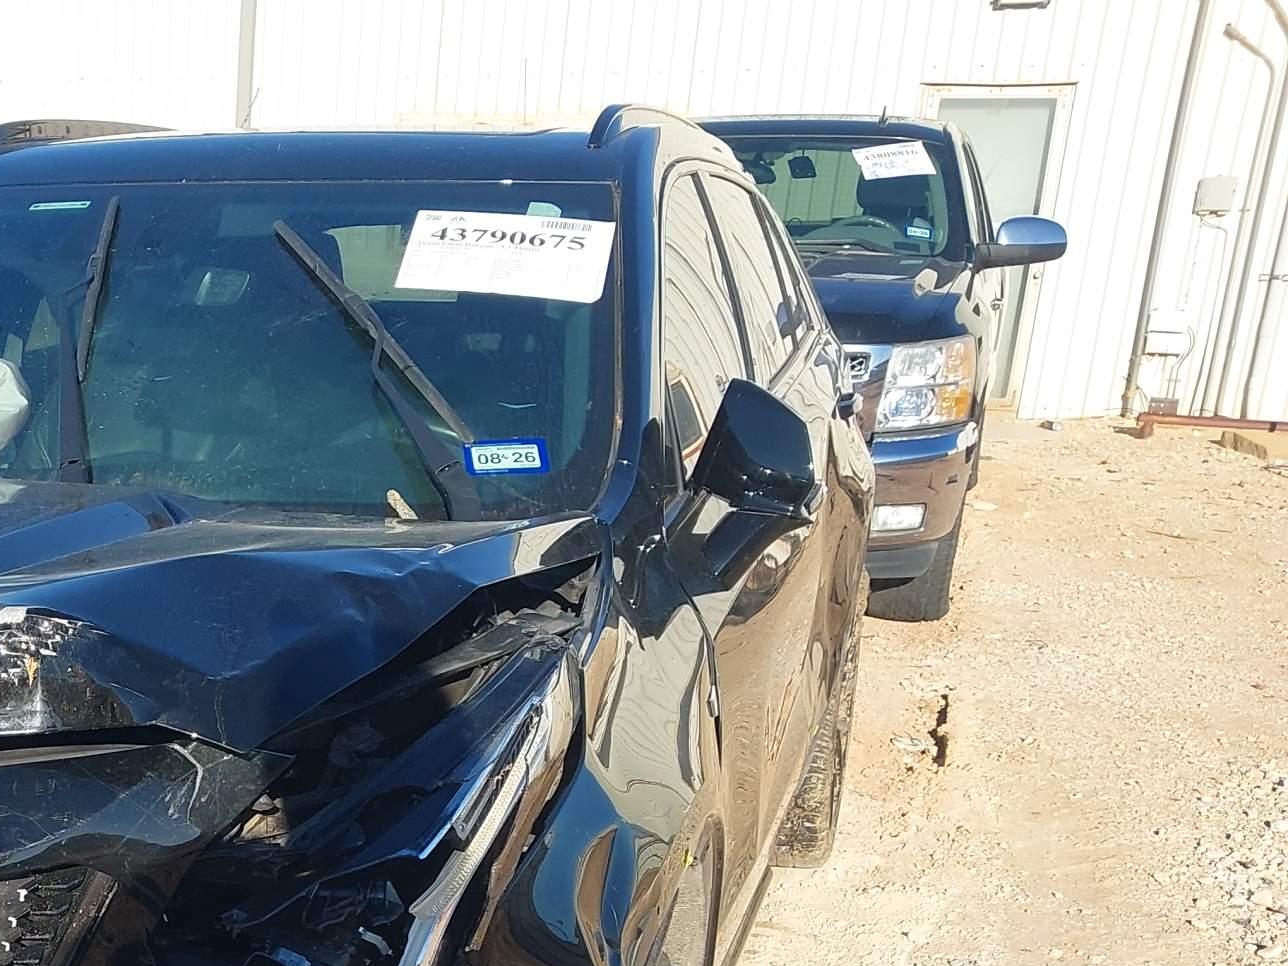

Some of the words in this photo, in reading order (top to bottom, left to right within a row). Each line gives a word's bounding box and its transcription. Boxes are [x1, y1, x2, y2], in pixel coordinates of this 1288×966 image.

[430, 225, 588, 251] 43790675
[477, 452, 502, 465] 08
[511, 451, 536, 463] 26
